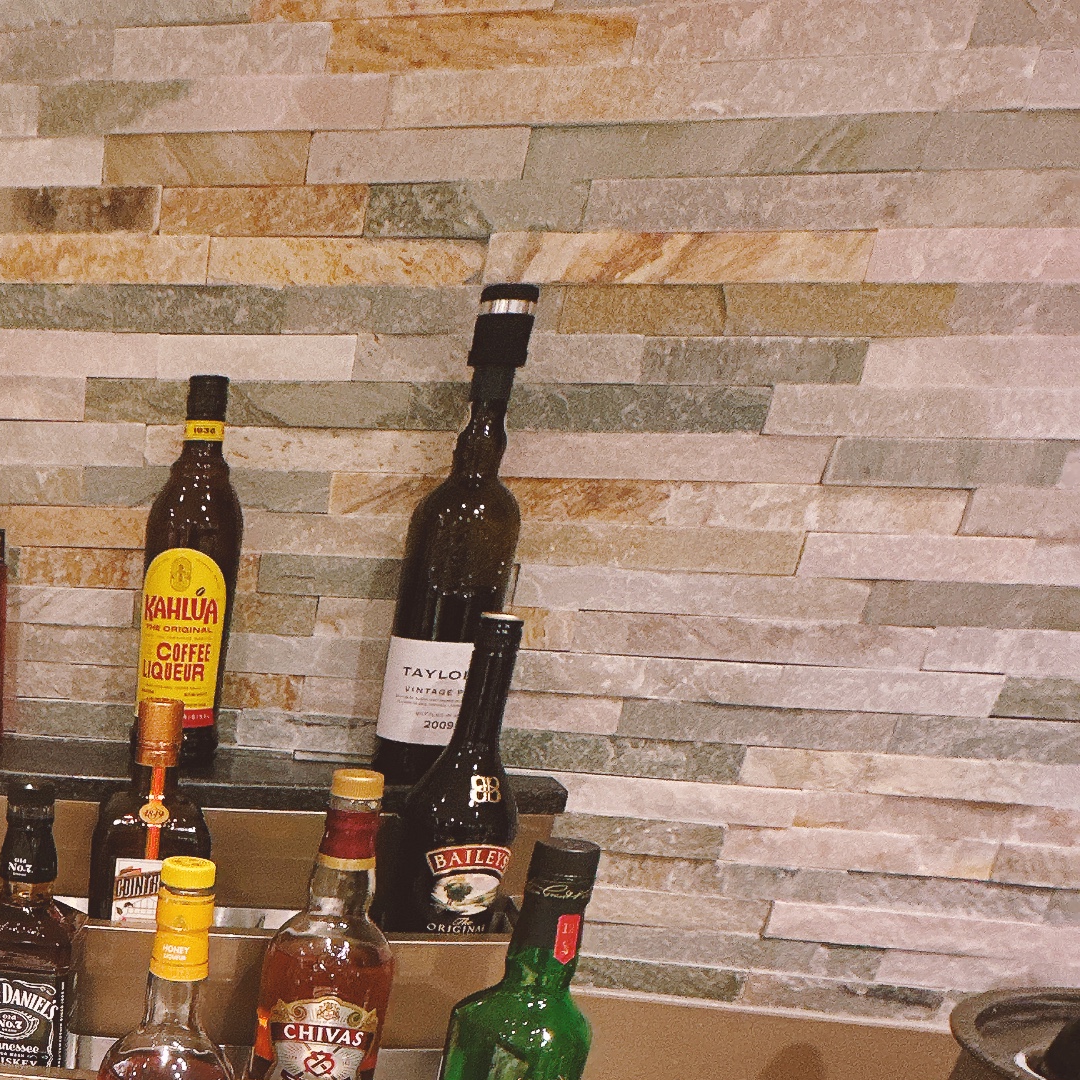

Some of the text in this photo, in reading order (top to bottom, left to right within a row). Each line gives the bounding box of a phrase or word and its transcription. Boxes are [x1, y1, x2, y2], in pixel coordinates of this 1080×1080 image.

[146, 623, 213, 634] THE ORIGINAL
[156, 641, 212, 663] COFFEE
[142, 659, 205, 682] LIQUEUR
[405, 686, 454, 697] VINTAGE
[423, 720, 454, 730] 2009
[434, 850, 510, 870] BAILEYS
[162, 944, 190, 955] HONEY
[1, 982, 59, 1020] DANIEL'S
[283, 1023, 364, 1047] CHIVAS
